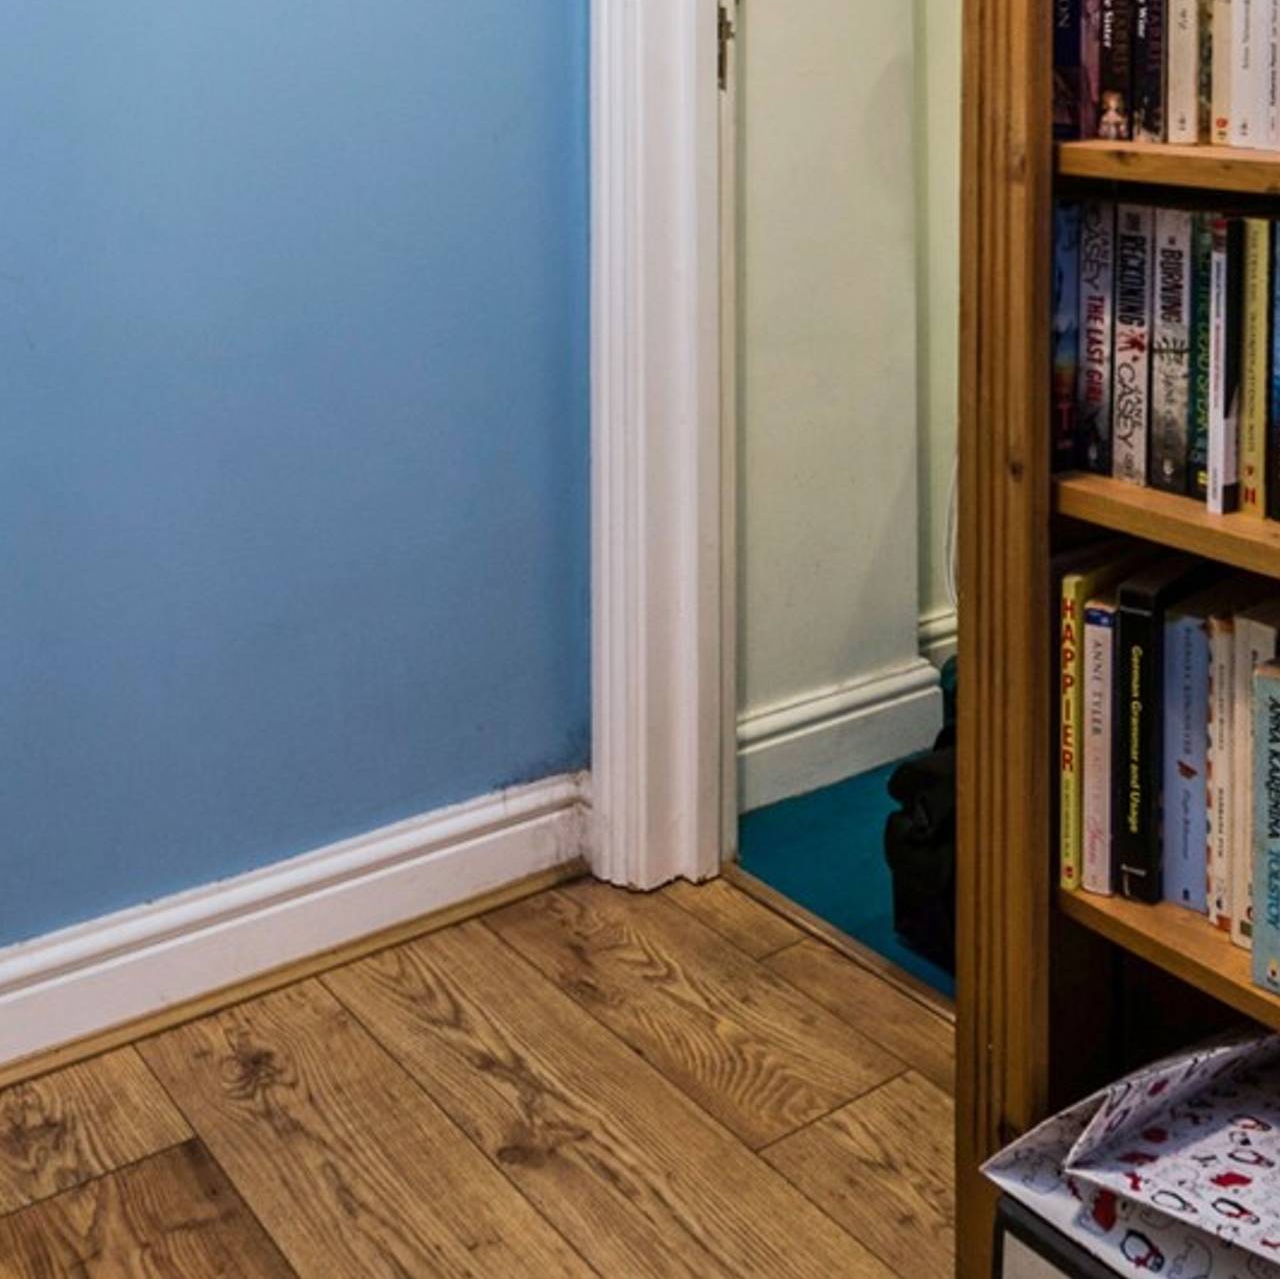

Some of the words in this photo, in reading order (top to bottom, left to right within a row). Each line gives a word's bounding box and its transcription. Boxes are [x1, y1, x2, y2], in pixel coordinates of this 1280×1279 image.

[1086, 294, 1106, 325] THE
[1119, 234, 1147, 328] RECKONING
[1161, 248, 1184, 323] BURNING
[1086, 327, 1106, 364] LAST
[1116, 362, 1136, 449] CASEY
